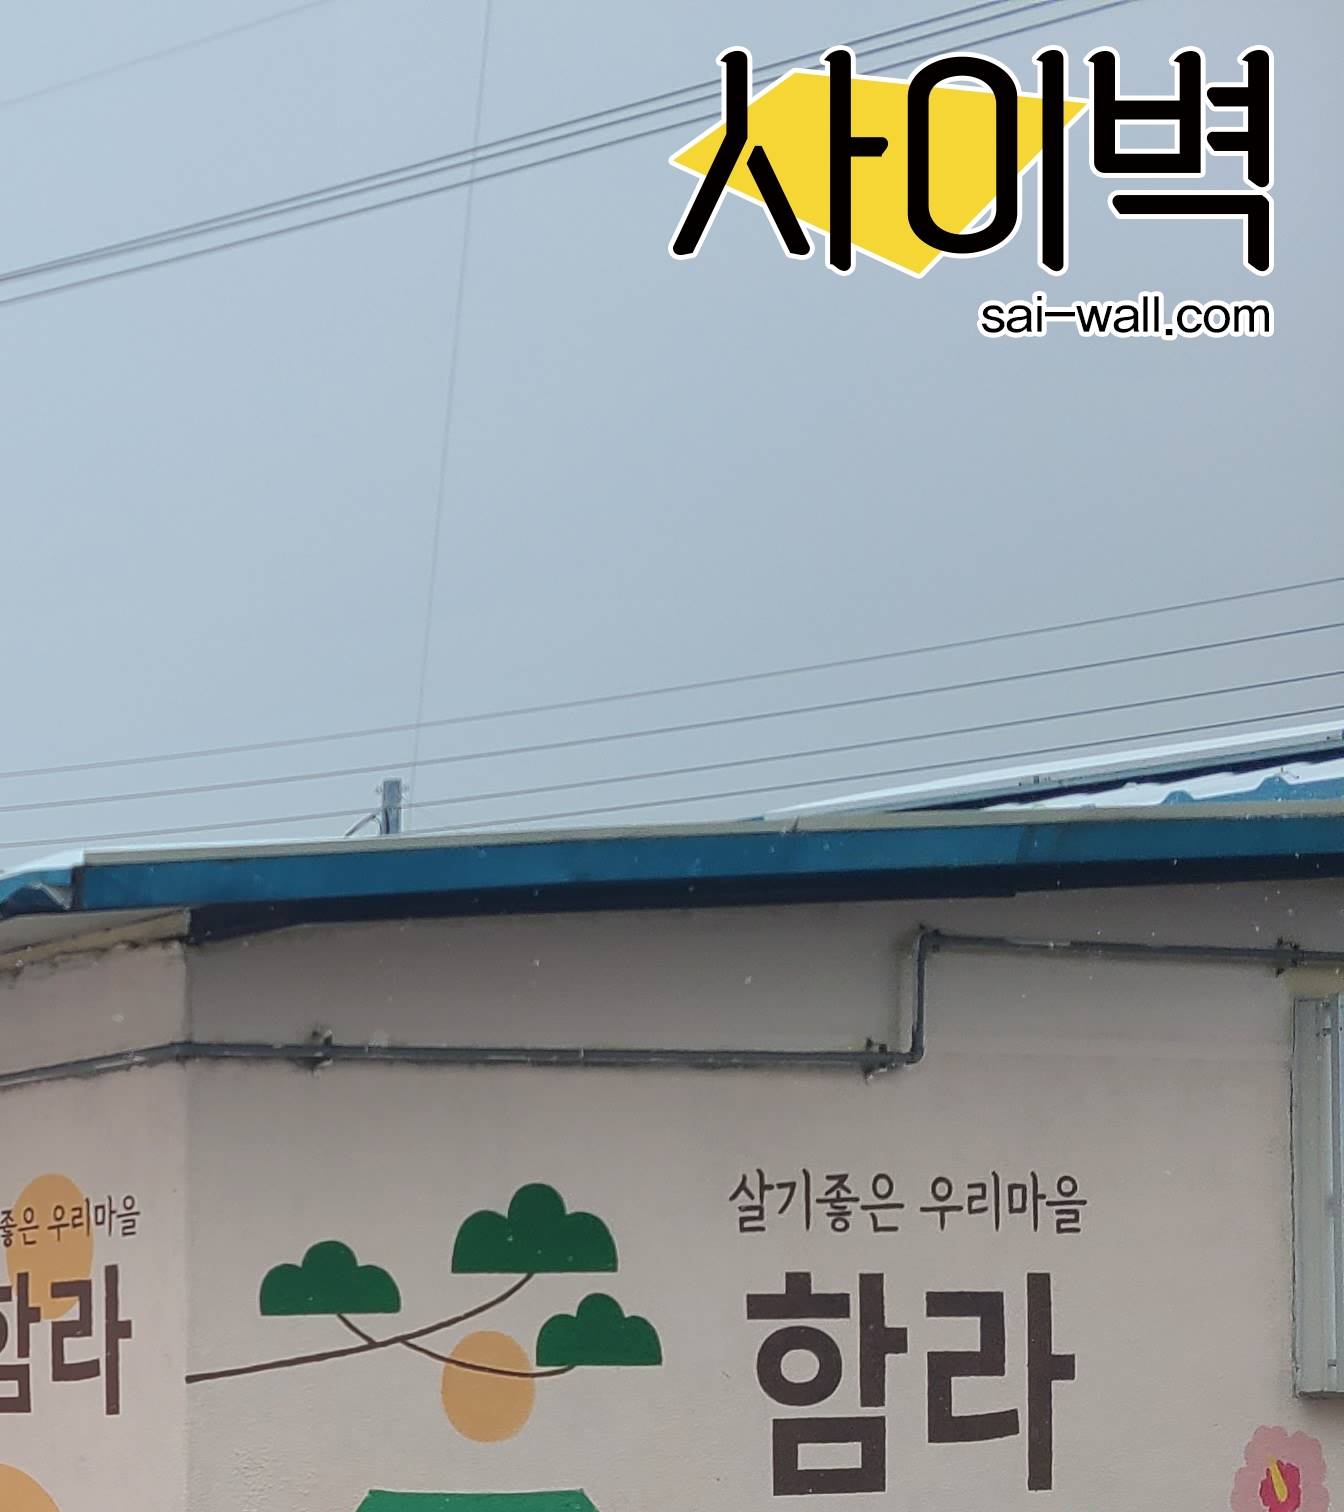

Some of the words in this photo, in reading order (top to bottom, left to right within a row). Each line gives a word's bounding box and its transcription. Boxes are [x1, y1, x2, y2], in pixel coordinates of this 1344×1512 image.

[46, 1194, 141, 1240] 우리마을
[729, 1168, 905, 1234] 살기좋은
[919, 1170, 1088, 1234] 우리마을
[746, 1271, 1076, 1496] 함라
